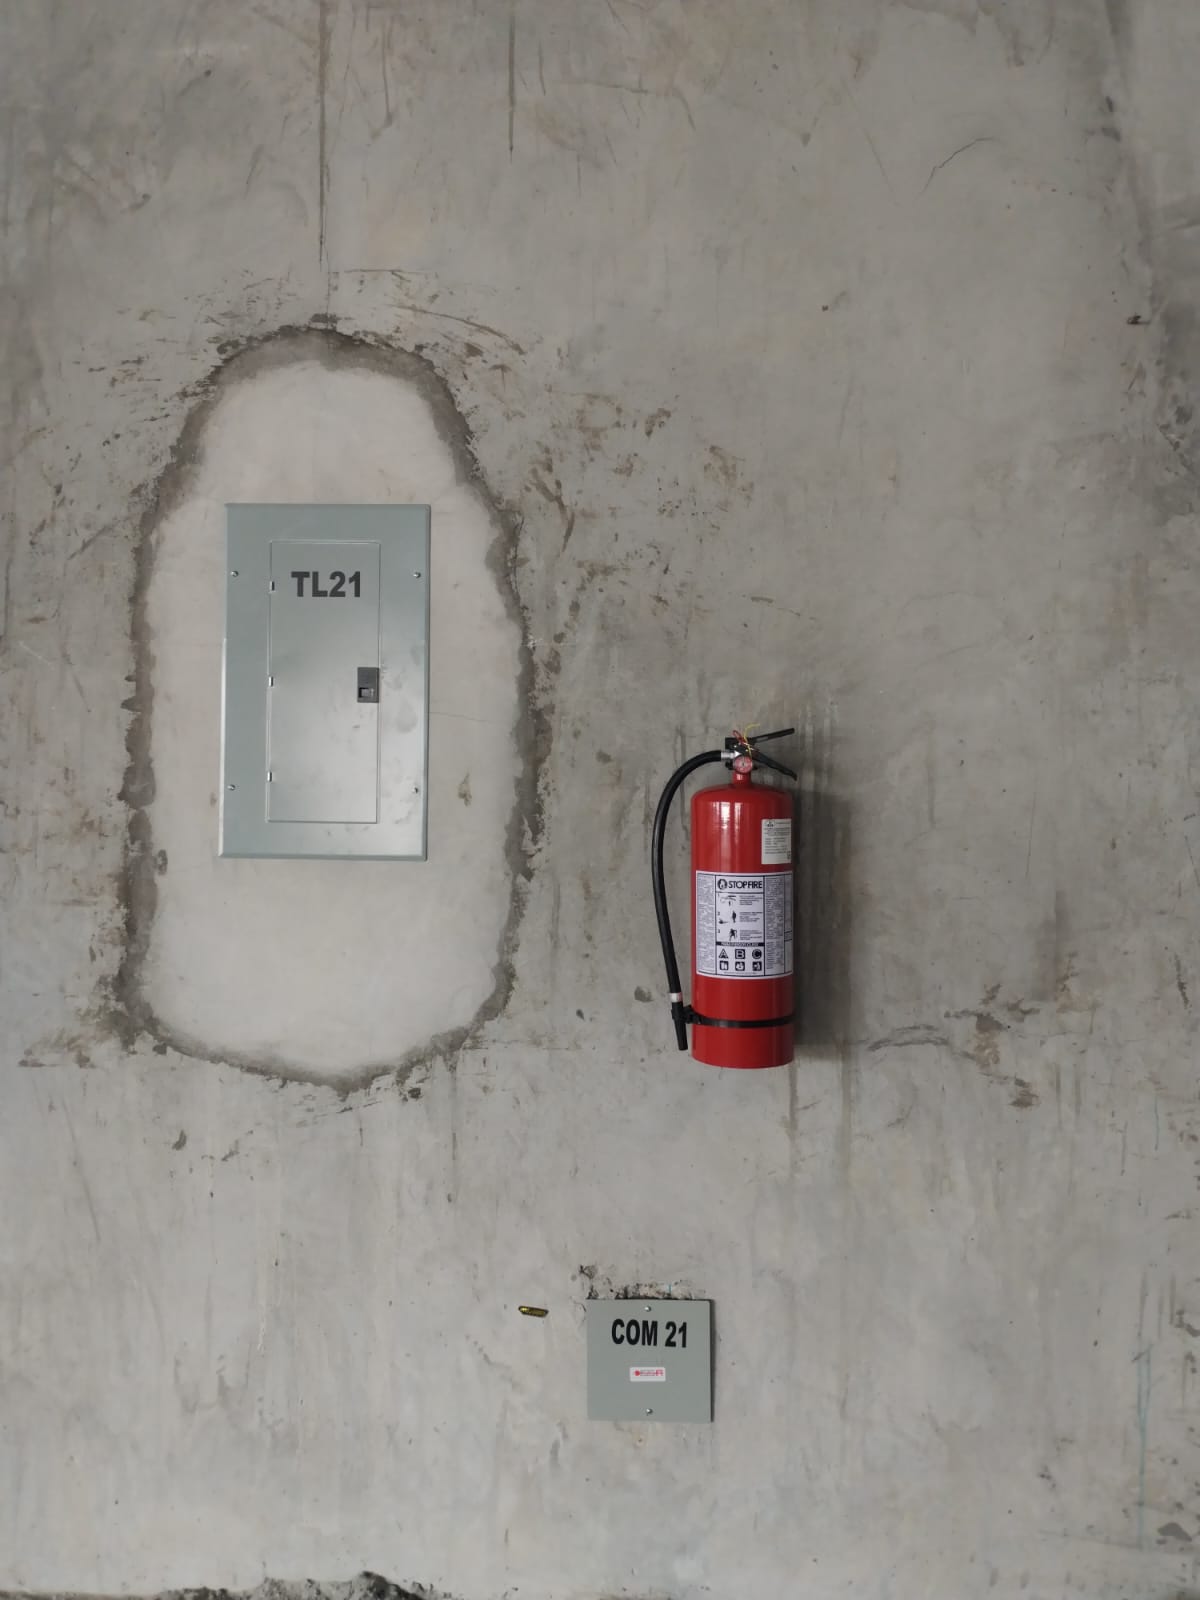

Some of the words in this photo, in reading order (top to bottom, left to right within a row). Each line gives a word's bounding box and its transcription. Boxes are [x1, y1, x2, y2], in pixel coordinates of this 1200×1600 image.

[291, 571, 361, 598] TL21
[736, 949, 745, 959] B
[752, 949, 762, 959] C
[611, 1318, 658, 1347] COM
[665, 1321, 687, 1348] 21
